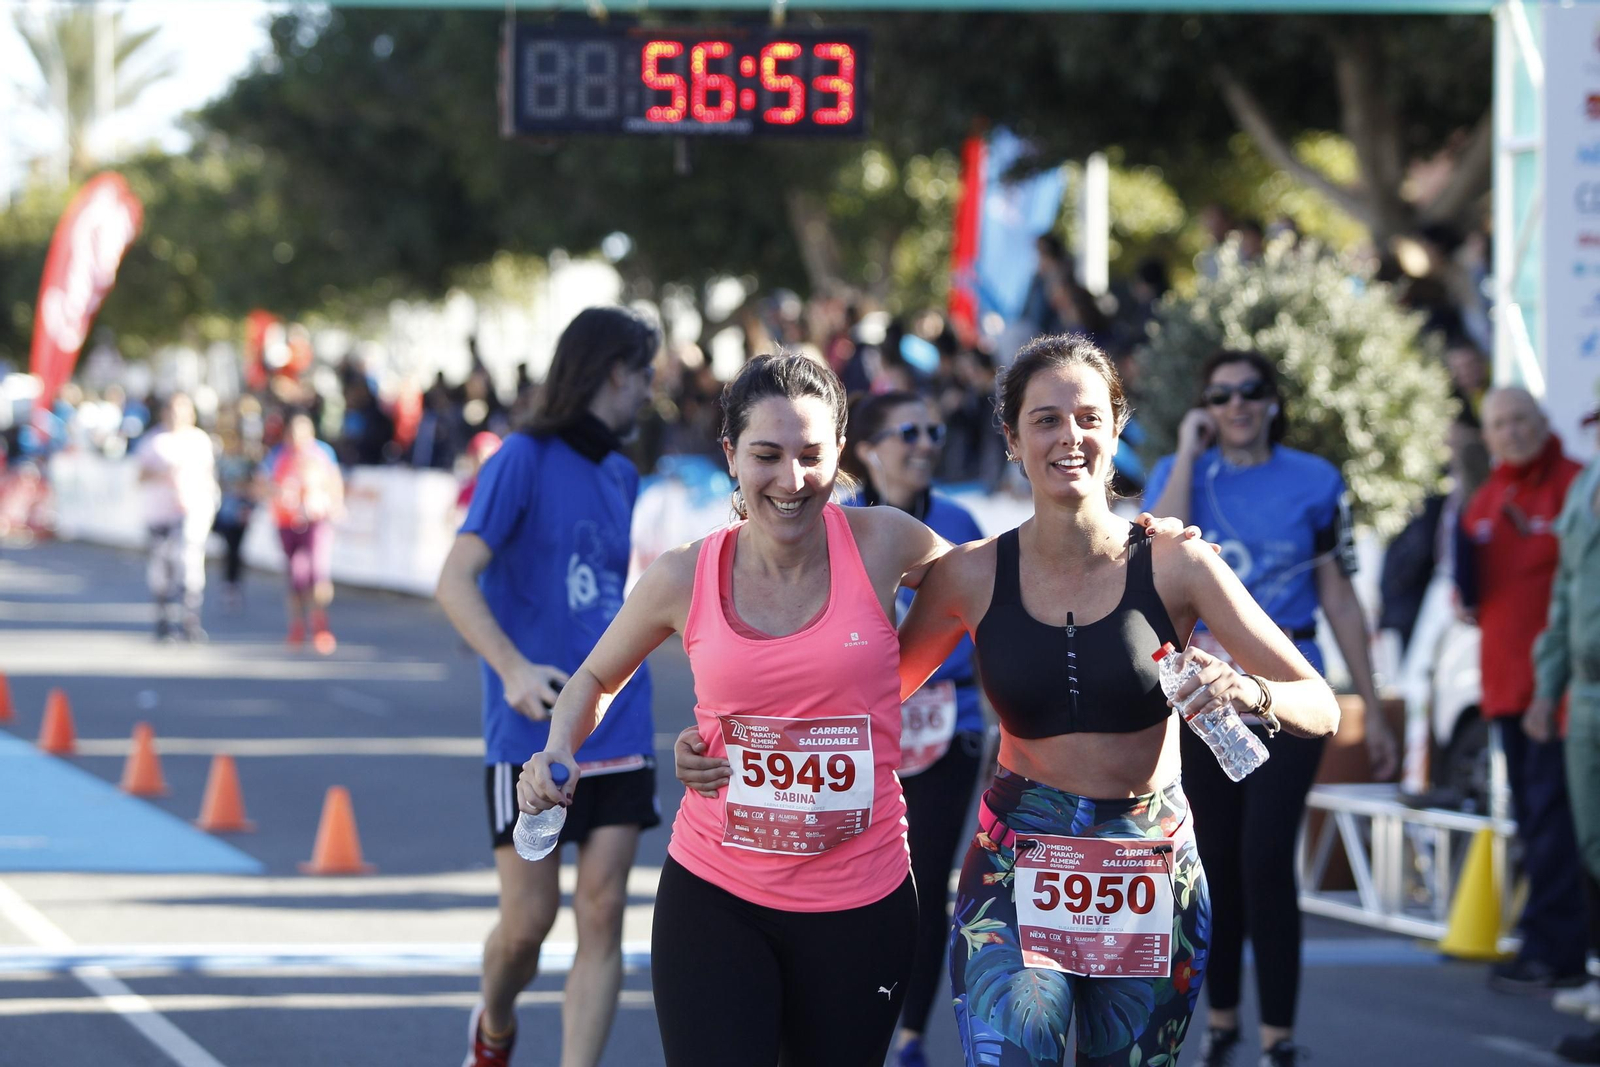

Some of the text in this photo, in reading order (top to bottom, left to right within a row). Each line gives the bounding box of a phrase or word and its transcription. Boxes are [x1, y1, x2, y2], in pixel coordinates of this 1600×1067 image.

[641, 40, 855, 124] 56:53
[1067, 651, 1080, 695] NIKE
[749, 725, 769, 733] MEDIO
[810, 726, 858, 735] CARRERA
[750, 731, 781, 739] MARATÓN
[798, 737, 859, 746] SALUDABLE
[742, 749, 856, 793] 5949
[773, 790, 816, 805] SABINA
[1050, 844, 1073, 852] MEDIO
[1050, 851, 1084, 859] MARATÓN
[1050, 857, 1080, 865] ALMERÍA
[1102, 859, 1163, 867] SALUDABLE
[1032, 871, 1156, 915] 5950
[1072, 914, 1110, 926] NIEVE
